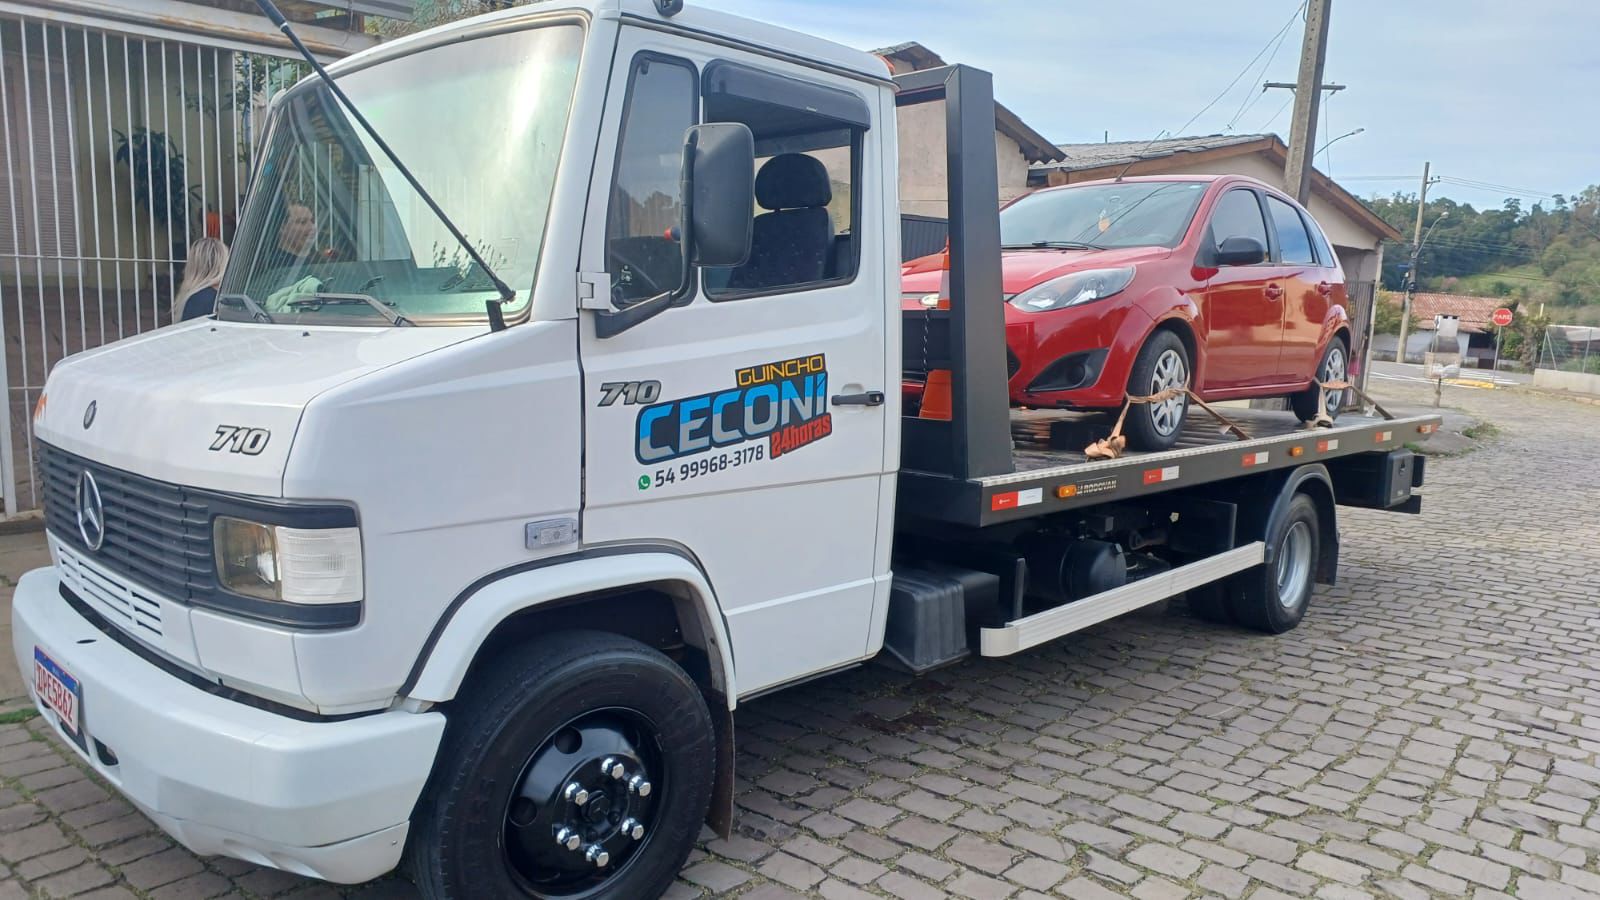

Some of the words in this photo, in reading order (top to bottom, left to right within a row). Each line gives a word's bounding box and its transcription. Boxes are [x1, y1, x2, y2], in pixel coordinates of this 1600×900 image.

[738, 355, 824, 386] GUINCHO
[598, 380, 661, 406] 710
[208, 424, 271, 456] 710
[771, 414, 831, 458] 24horas
[655, 468, 676, 488] 54
[680, 444, 764, 481] 99968-3178
